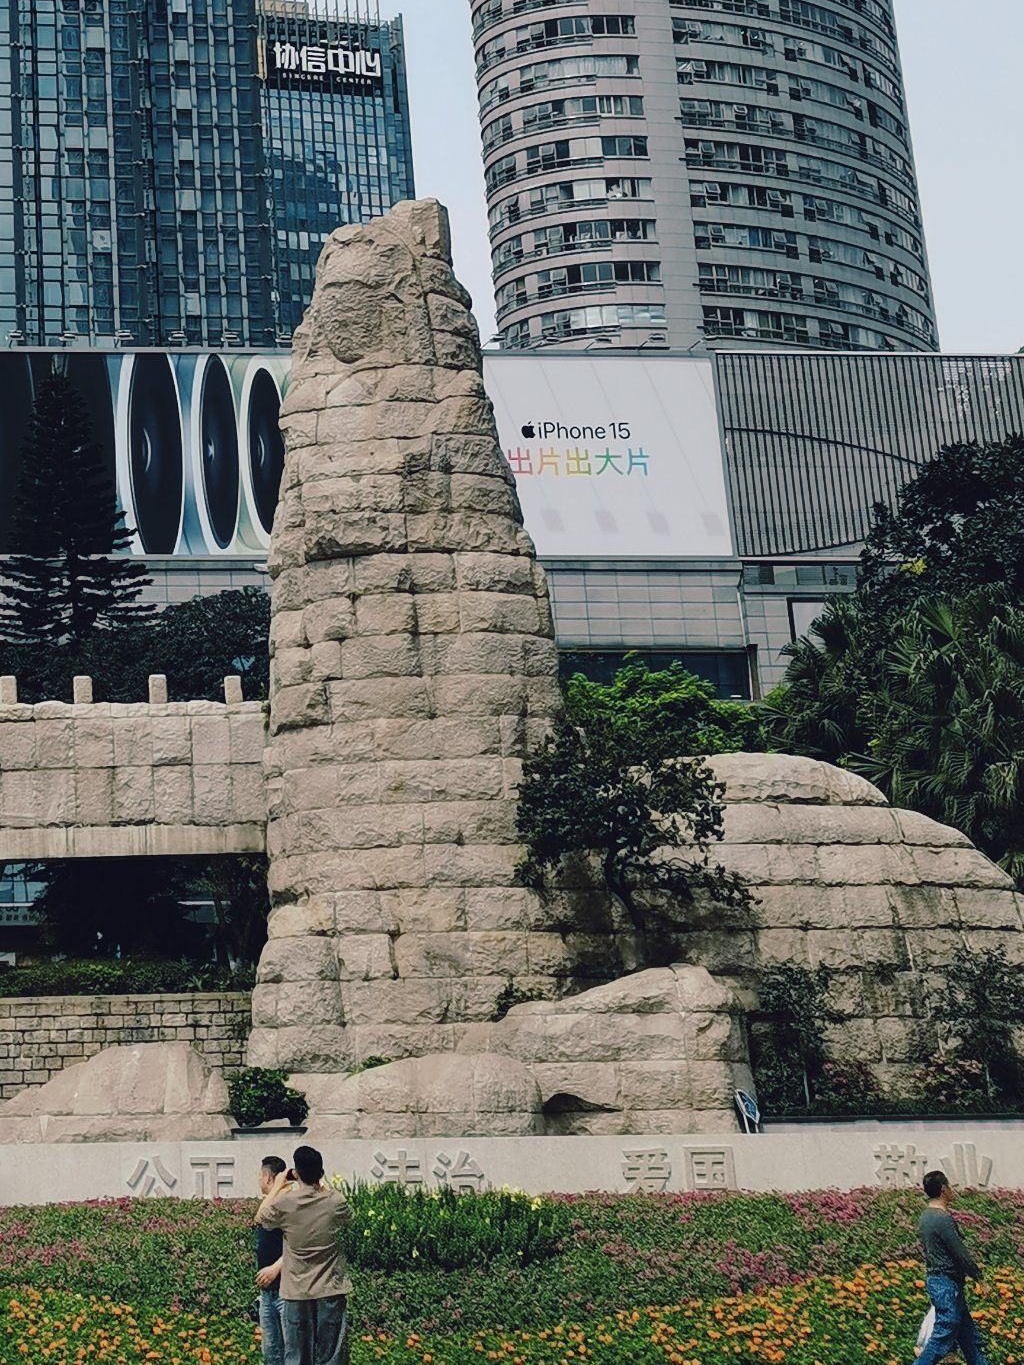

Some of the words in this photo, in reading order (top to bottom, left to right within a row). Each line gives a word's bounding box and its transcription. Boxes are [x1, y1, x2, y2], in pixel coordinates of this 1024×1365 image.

[273, 42, 381, 77] 协信中心
[282, 72, 324, 82] SINCERE
[336, 75, 372, 85] CENTER
[538, 421, 606, 439] iPhone
[609, 422, 631, 439] 15
[507, 446, 650, 476] 出片出大片
[126, 1155, 236, 1198] 公正
[370, 1148, 485, 1195] 法治
[621, 1145, 738, 1191] 爱国
[873, 1142, 993, 1190] 敬业
